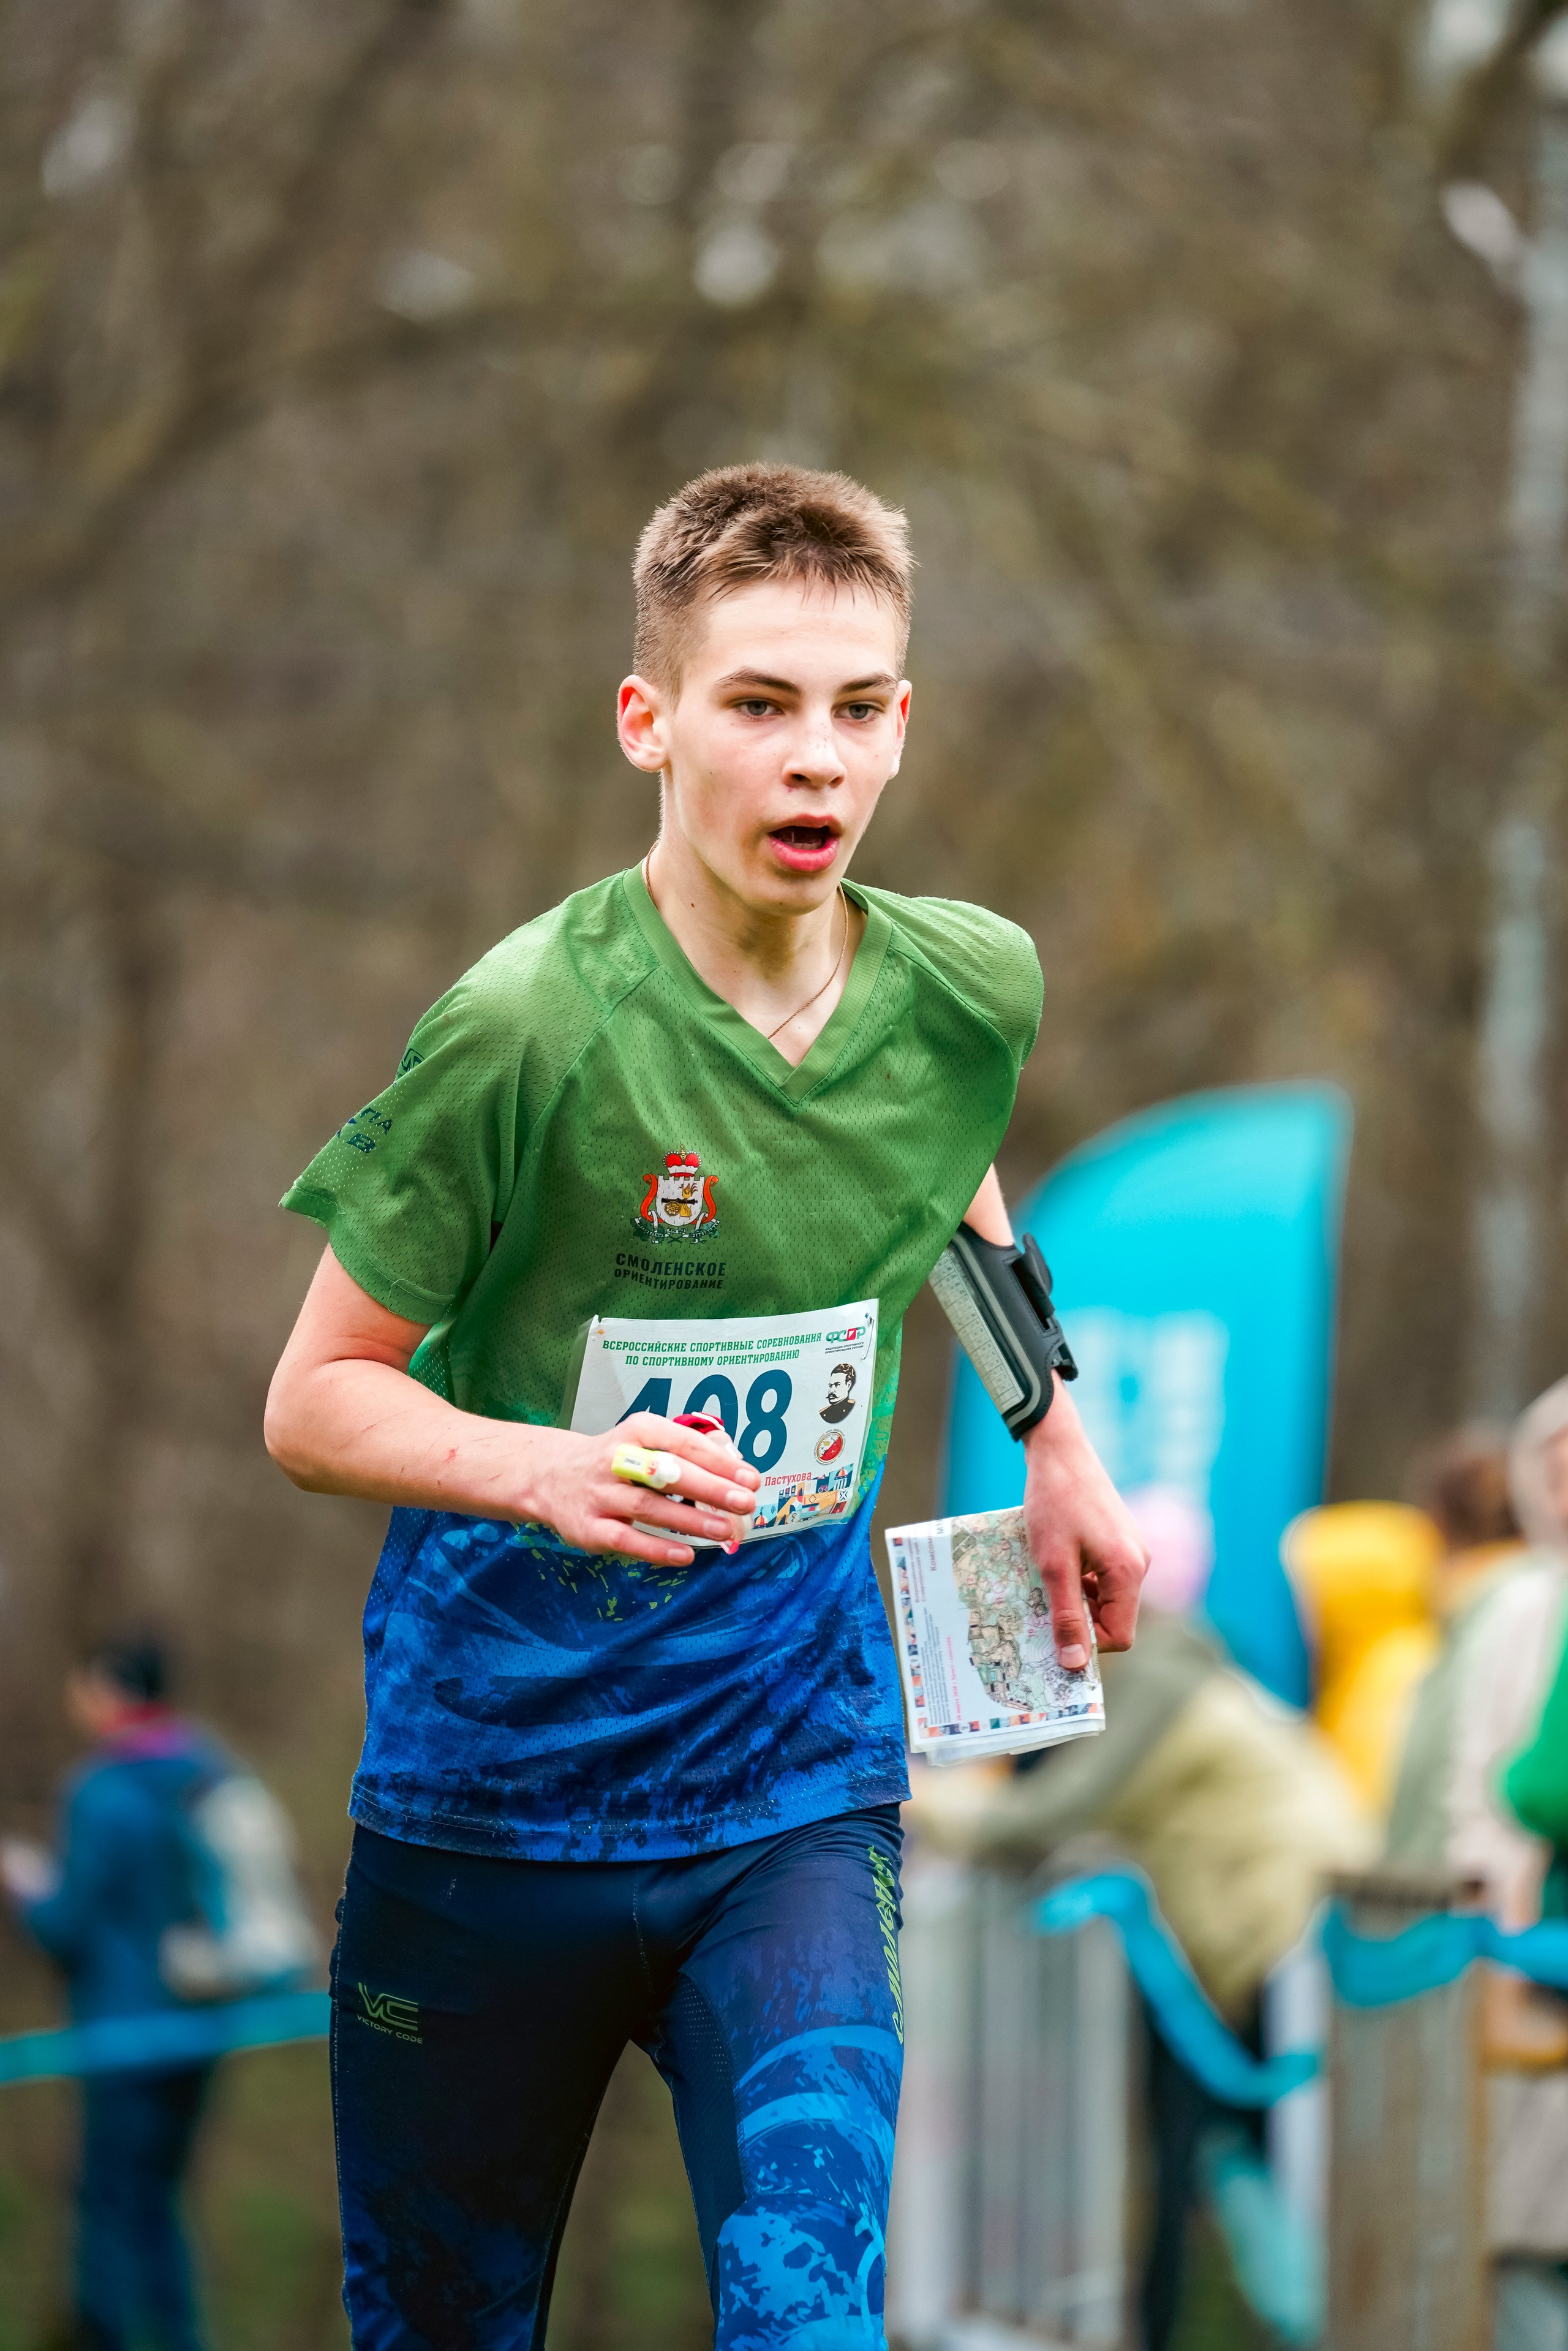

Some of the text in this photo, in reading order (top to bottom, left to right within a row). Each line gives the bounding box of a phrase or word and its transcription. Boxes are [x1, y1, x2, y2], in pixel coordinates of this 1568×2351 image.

[616, 1253, 726, 1277] СМОЛЕНСКОЕ
[614, 1269, 724, 1289] ОРИЕНТИРОВАНИЕ
[603, 1332, 822, 1352] ВСЕРОССИЙСКИЕ СПОРТИВНЫЕ СОРЕВНОВАНИЯ
[625, 1349, 799, 1366] ПО СПОРТИВНОМУ ОРИЕНТИРОВАНИЮ
[764, 1472, 812, 1487] Пастухова
[356, 2013, 423, 2044] VICTORY CODE
